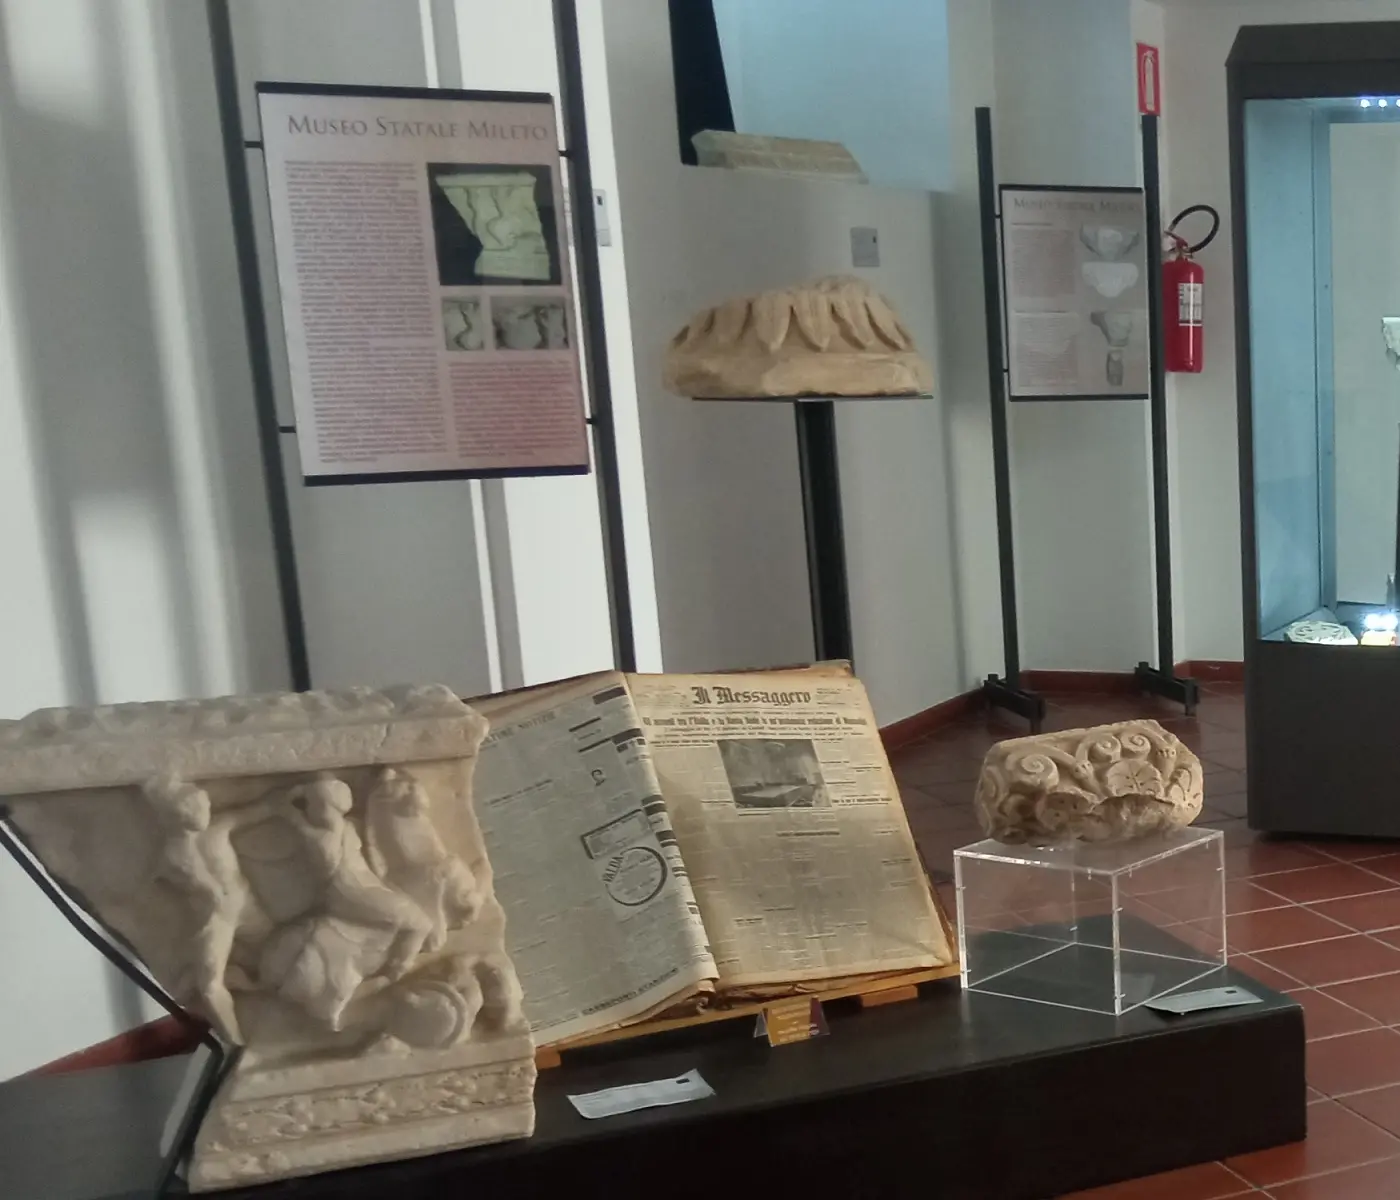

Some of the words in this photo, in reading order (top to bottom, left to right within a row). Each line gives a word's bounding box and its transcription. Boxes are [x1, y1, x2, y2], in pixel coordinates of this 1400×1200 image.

[287, 114, 368, 137] MUSEO
[375, 116, 458, 139] STATALE
[712, 686, 812, 707] Messaggero
[603, 856, 624, 882] VALDA
